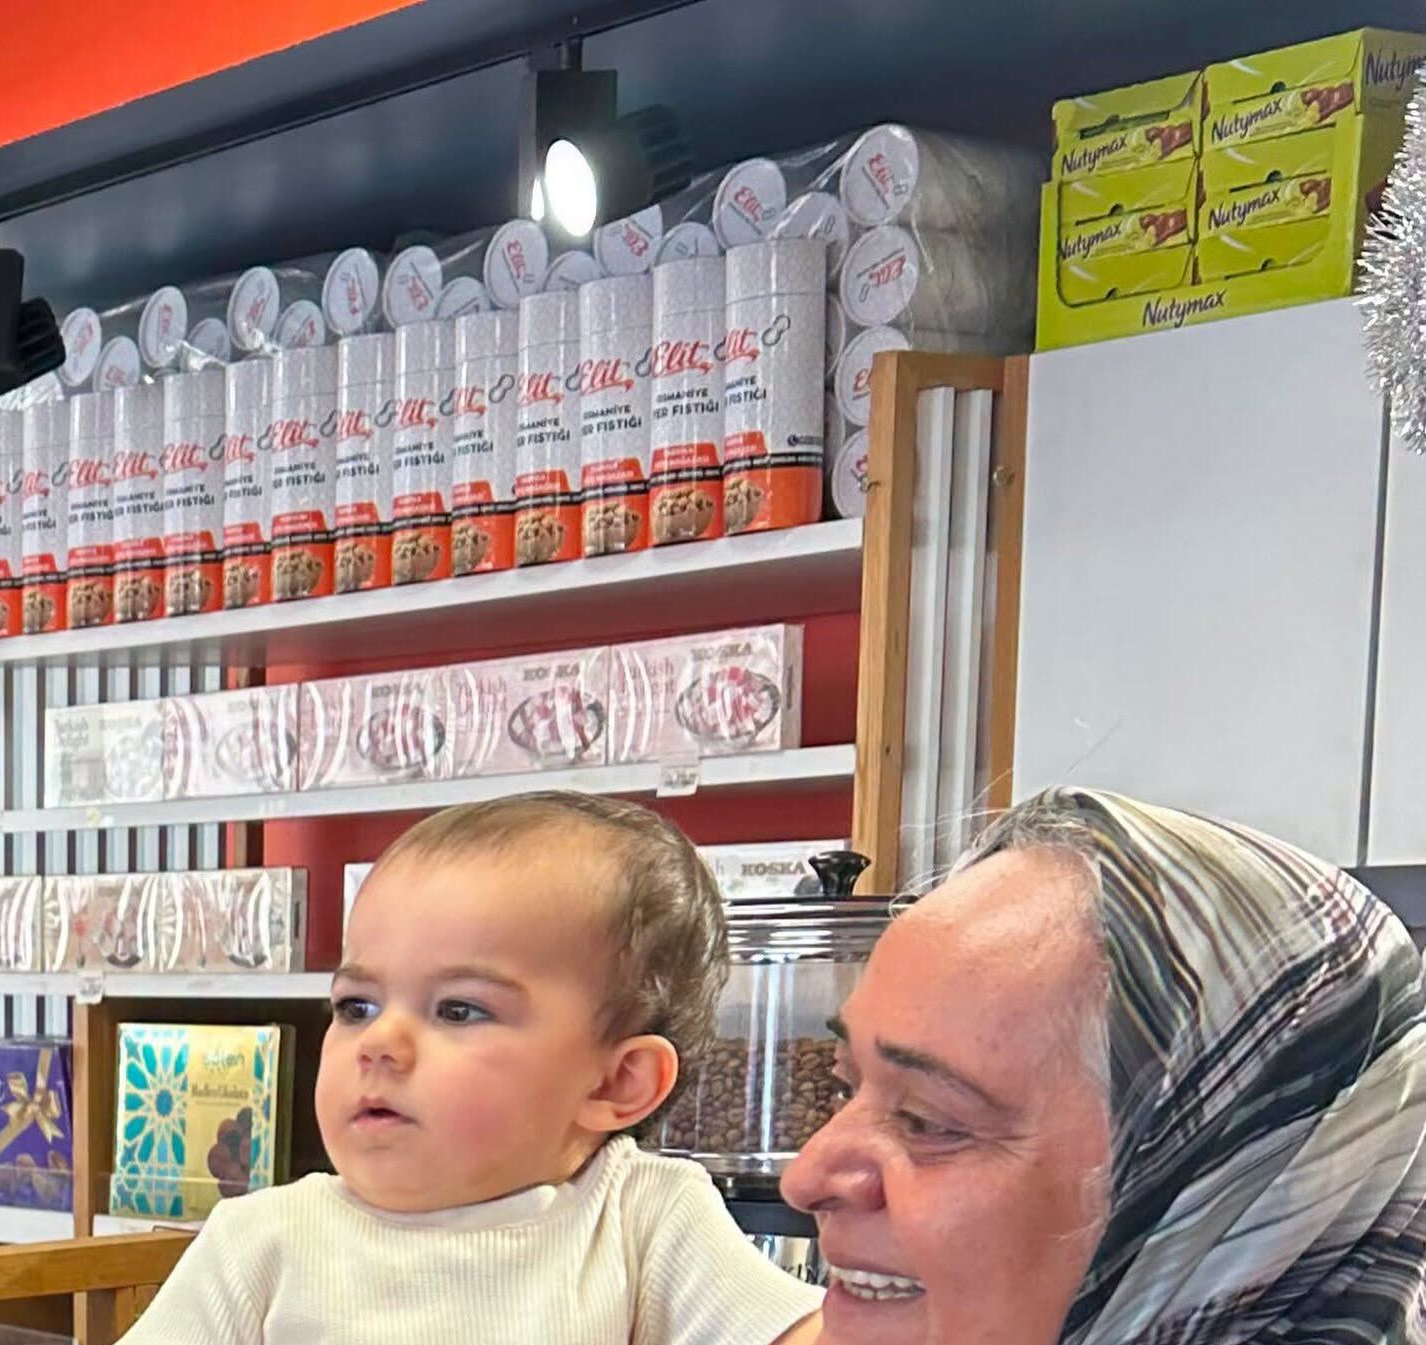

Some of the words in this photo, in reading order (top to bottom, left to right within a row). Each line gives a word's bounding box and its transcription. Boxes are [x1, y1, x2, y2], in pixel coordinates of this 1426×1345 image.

[1211, 97, 1283, 143] Nutymax
[1061, 135, 1128, 174] Nutymax
[1208, 186, 1280, 229] Nutymax
[1142, 288, 1227, 327] Nutymax
[651, 340, 714, 379] Elit
[723, 327, 761, 365] lit
[596, 416, 643, 432] FISTIĞI
[672, 403, 720, 418] FISTIĞI
[741, 860, 807, 877] KOSKA
